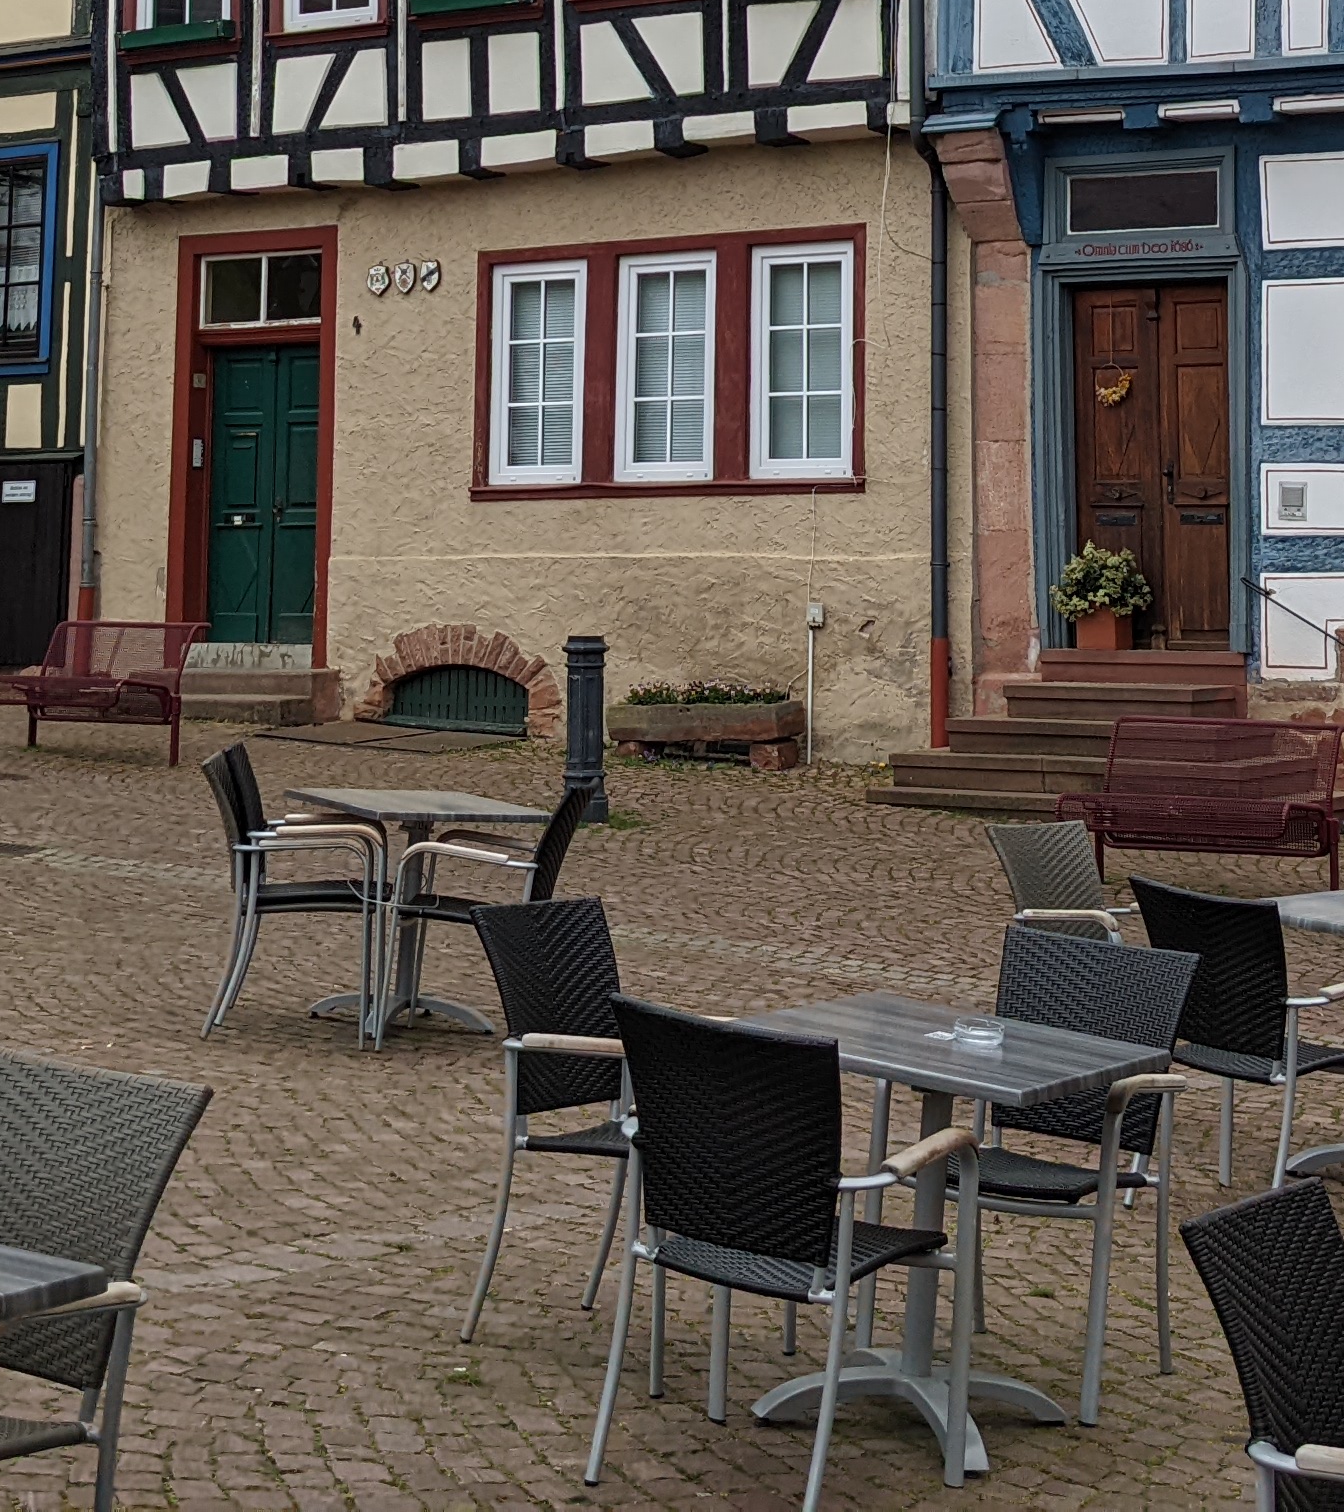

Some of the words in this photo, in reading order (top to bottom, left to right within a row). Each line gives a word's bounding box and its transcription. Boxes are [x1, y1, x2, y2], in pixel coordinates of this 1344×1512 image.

[1118, 243, 1140, 255] cum
[1142, 242, 1168, 254] Deo
[352, 315, 362, 335] 4
